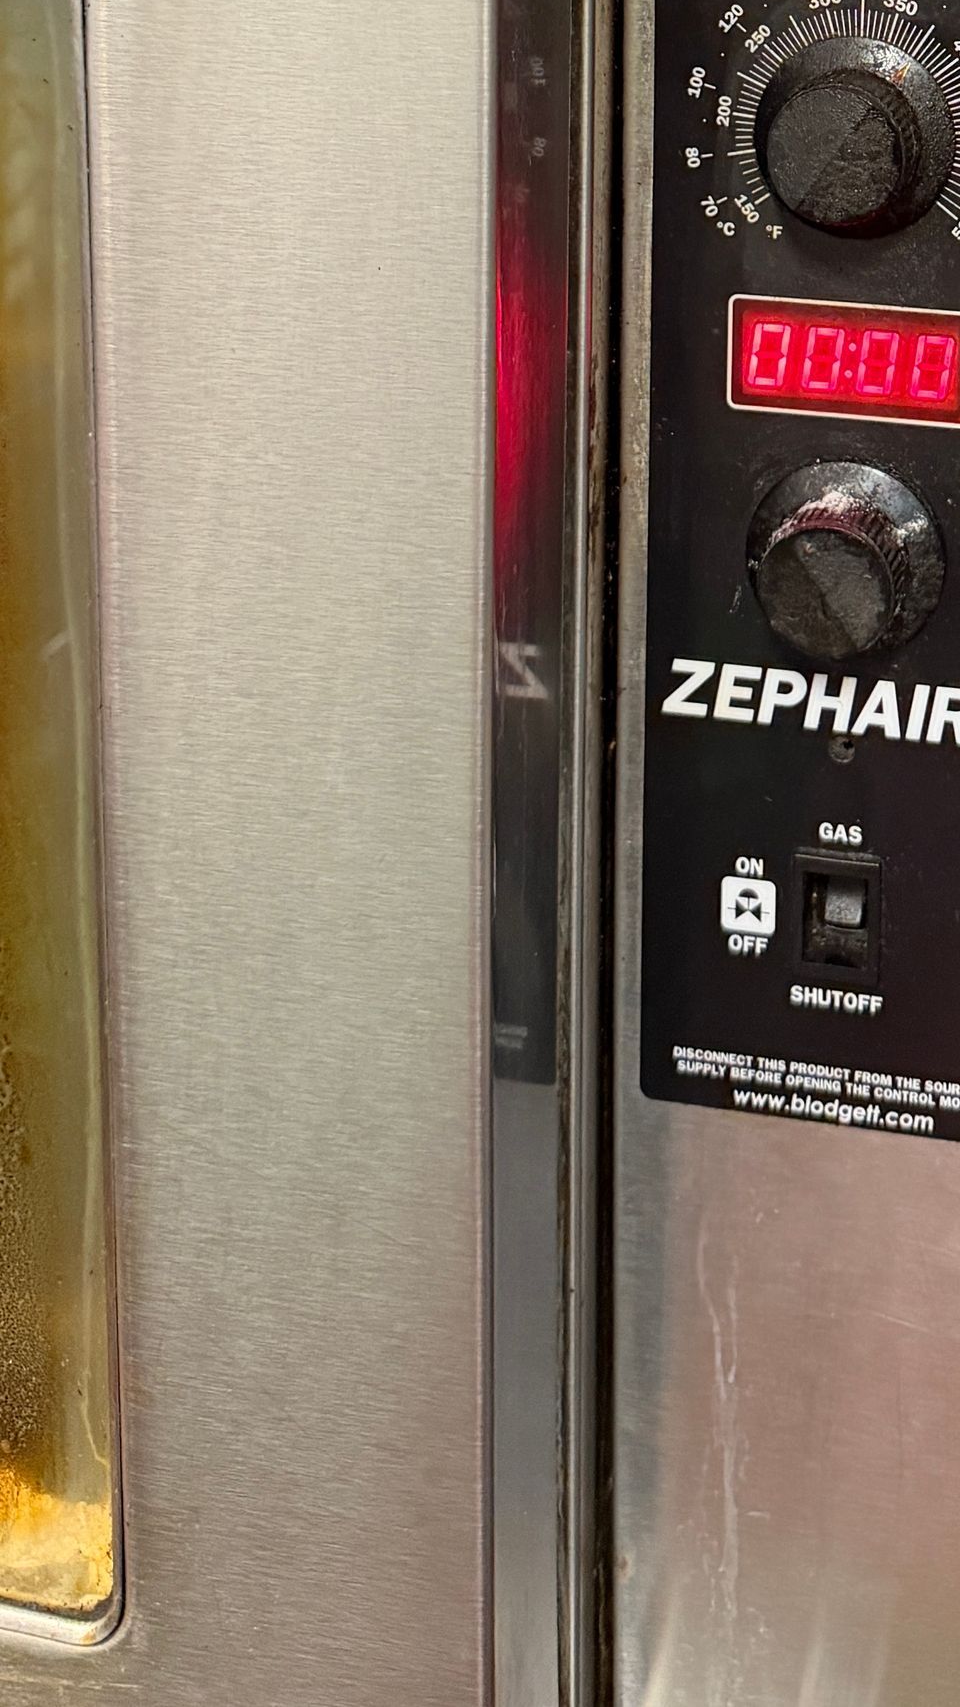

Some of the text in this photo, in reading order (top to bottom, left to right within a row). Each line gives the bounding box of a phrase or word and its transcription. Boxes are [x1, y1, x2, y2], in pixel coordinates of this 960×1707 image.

[718, 3, 744, 34] 120
[744, 24, 771, 54] 250
[687, 66, 706, 99] 100
[716, 95, 732, 127] 200
[684, 147, 701, 168] 80
[700, 195, 719, 217] 70
[734, 194, 760, 224] 150
[716, 221, 736, 237] °C
[765, 224, 783, 240] °F
[747, 321, 956, 401] 00:00
[818, 821, 863, 845] GAS
[735, 856, 764, 877] ON
[728, 934, 769, 957] OFF
[789, 984, 883, 1016] SHUTOFF
[672, 1045, 753, 1069] DISCONNECT
[757, 1056, 787, 1073] THIS
[789, 1061, 851, 1081] PRODUCT
[854, 1070, 893, 1089] FROM
[895, 1076, 922, 1093] THE
[676, 1059, 727, 1079] SUPPLY
[729, 1066, 782, 1087] BEFORE
[785, 1073, 842, 1094] OPENING
[844, 1081, 871, 1098] THE
[873, 1086, 936, 1108] CONTROL
[733, 1088, 935, 1134] www.blodgett.com
